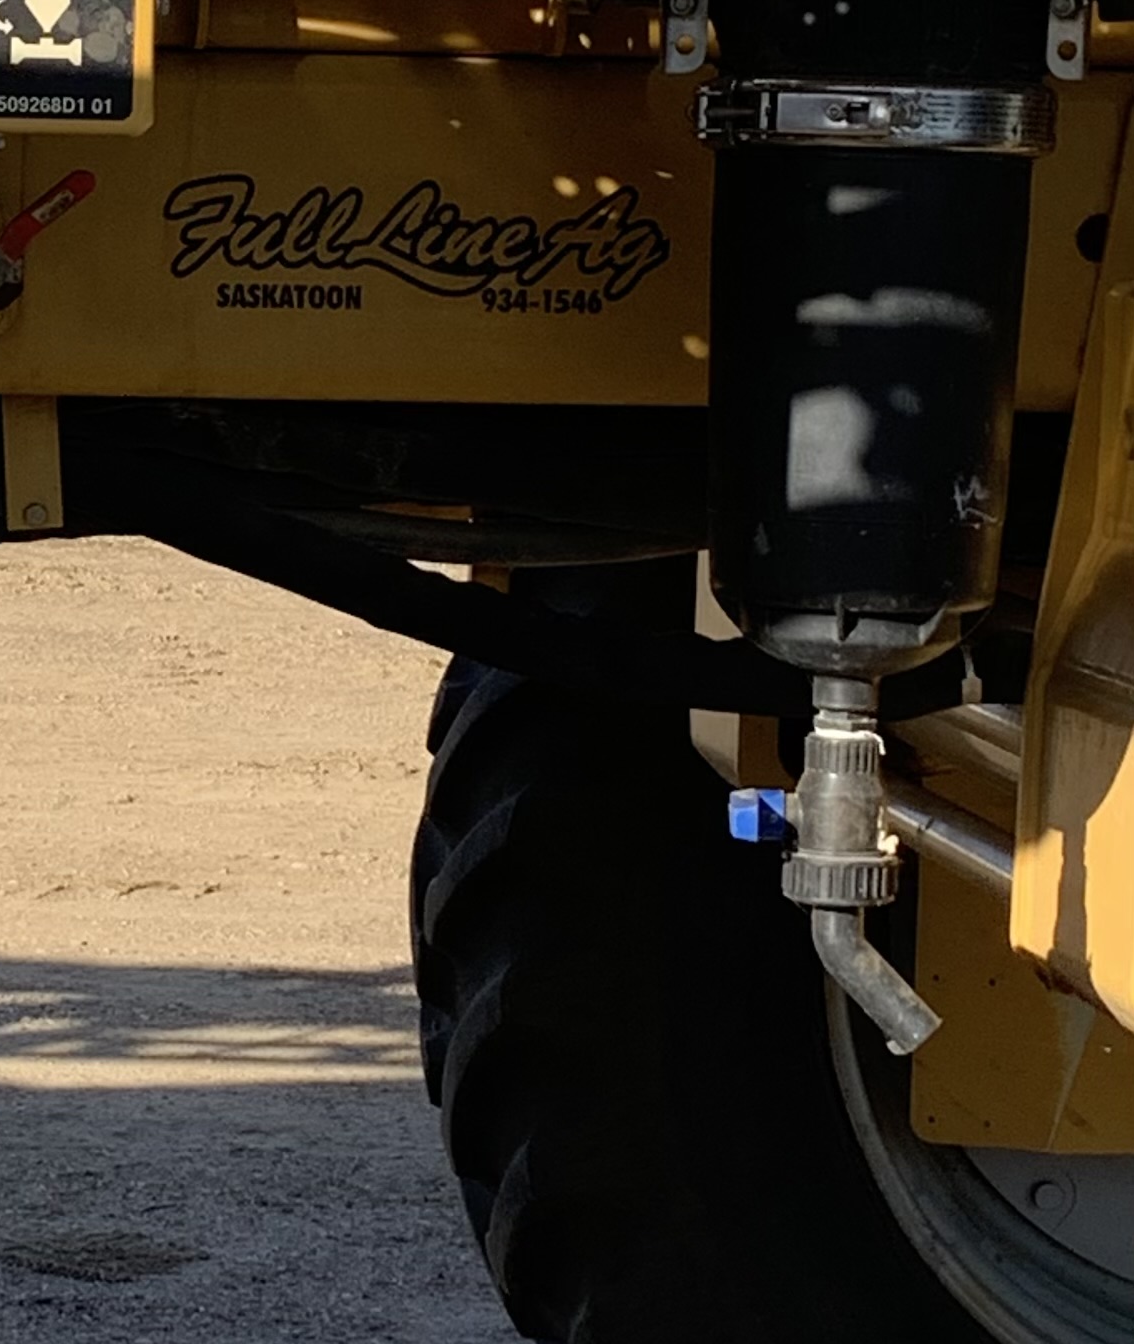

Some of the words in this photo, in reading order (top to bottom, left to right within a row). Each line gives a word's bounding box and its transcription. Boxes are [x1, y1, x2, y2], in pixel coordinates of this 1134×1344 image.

[90, 97, 113, 115] 01
[163, 173, 366, 278] Full
[354, 179, 544, 298] Line
[517, 185, 670, 301] Ag
[215, 282, 363, 310] SASKATOON
[480, 287, 604, 315] 934-1546
